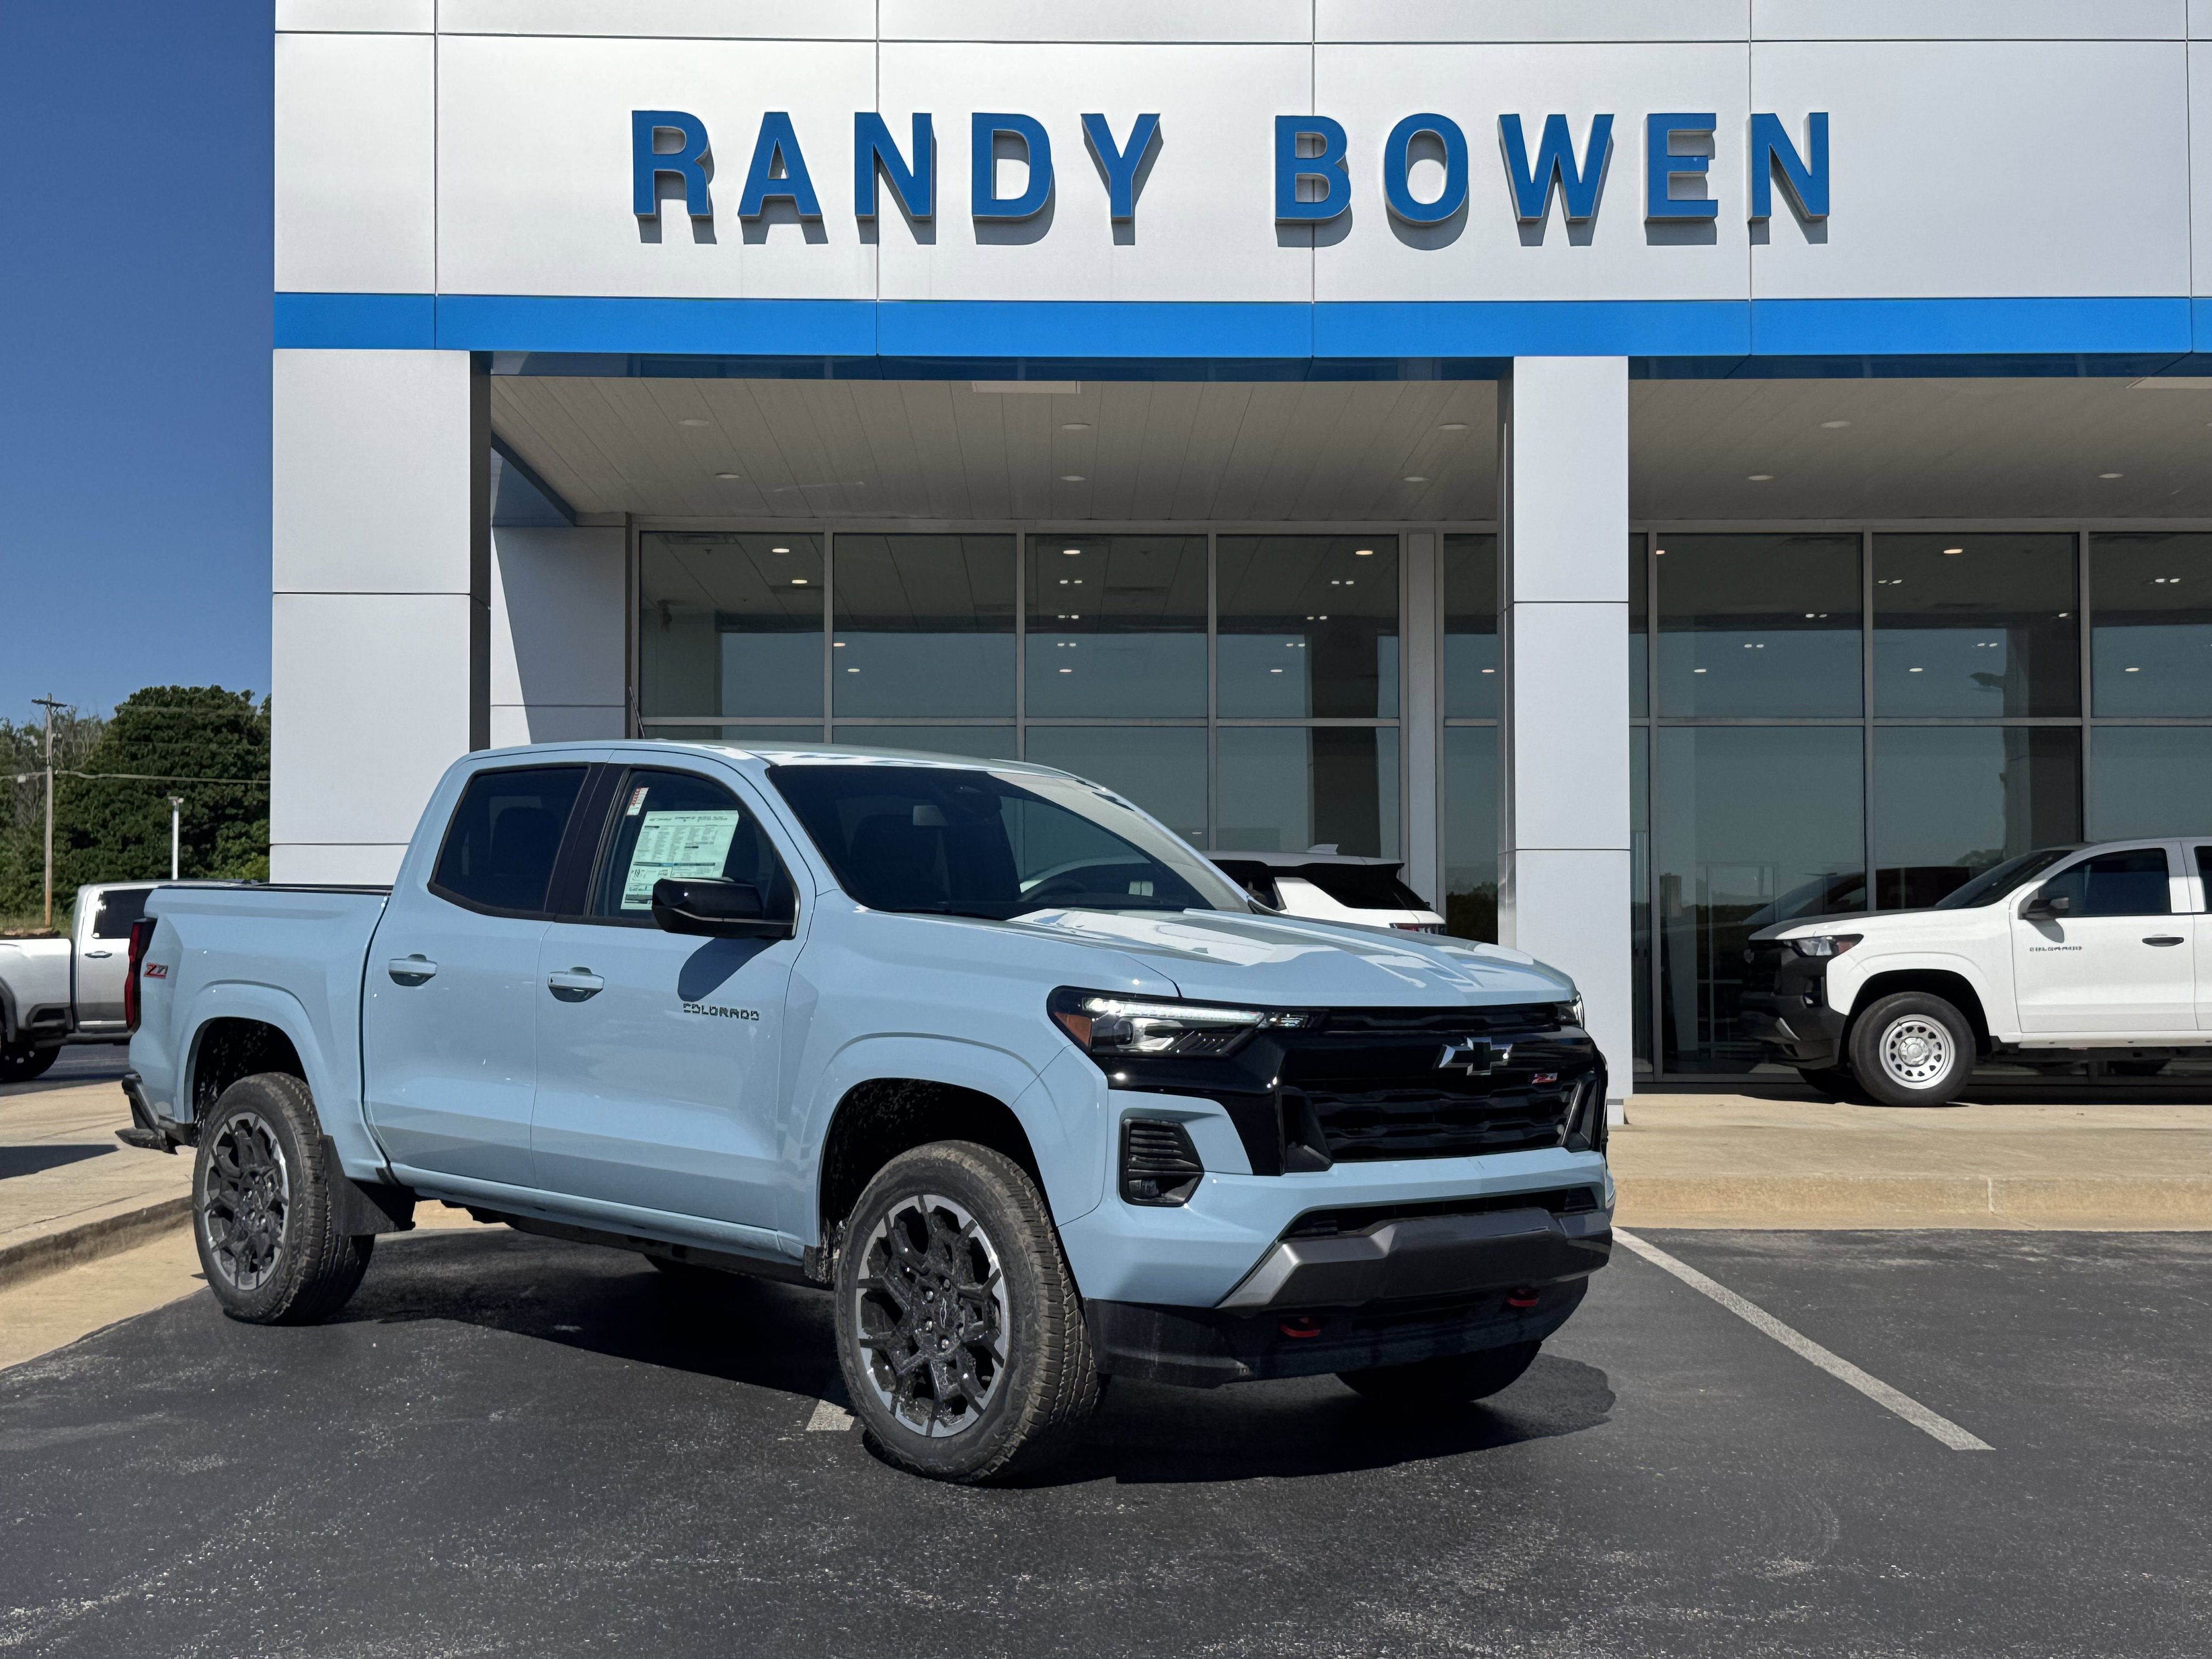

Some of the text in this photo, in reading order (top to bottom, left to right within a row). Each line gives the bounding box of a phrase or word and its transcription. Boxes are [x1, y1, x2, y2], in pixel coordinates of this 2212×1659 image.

[632, 110, 1830, 222] RANDY BOWEN
[683, 1003, 759, 1021] COLORADO
